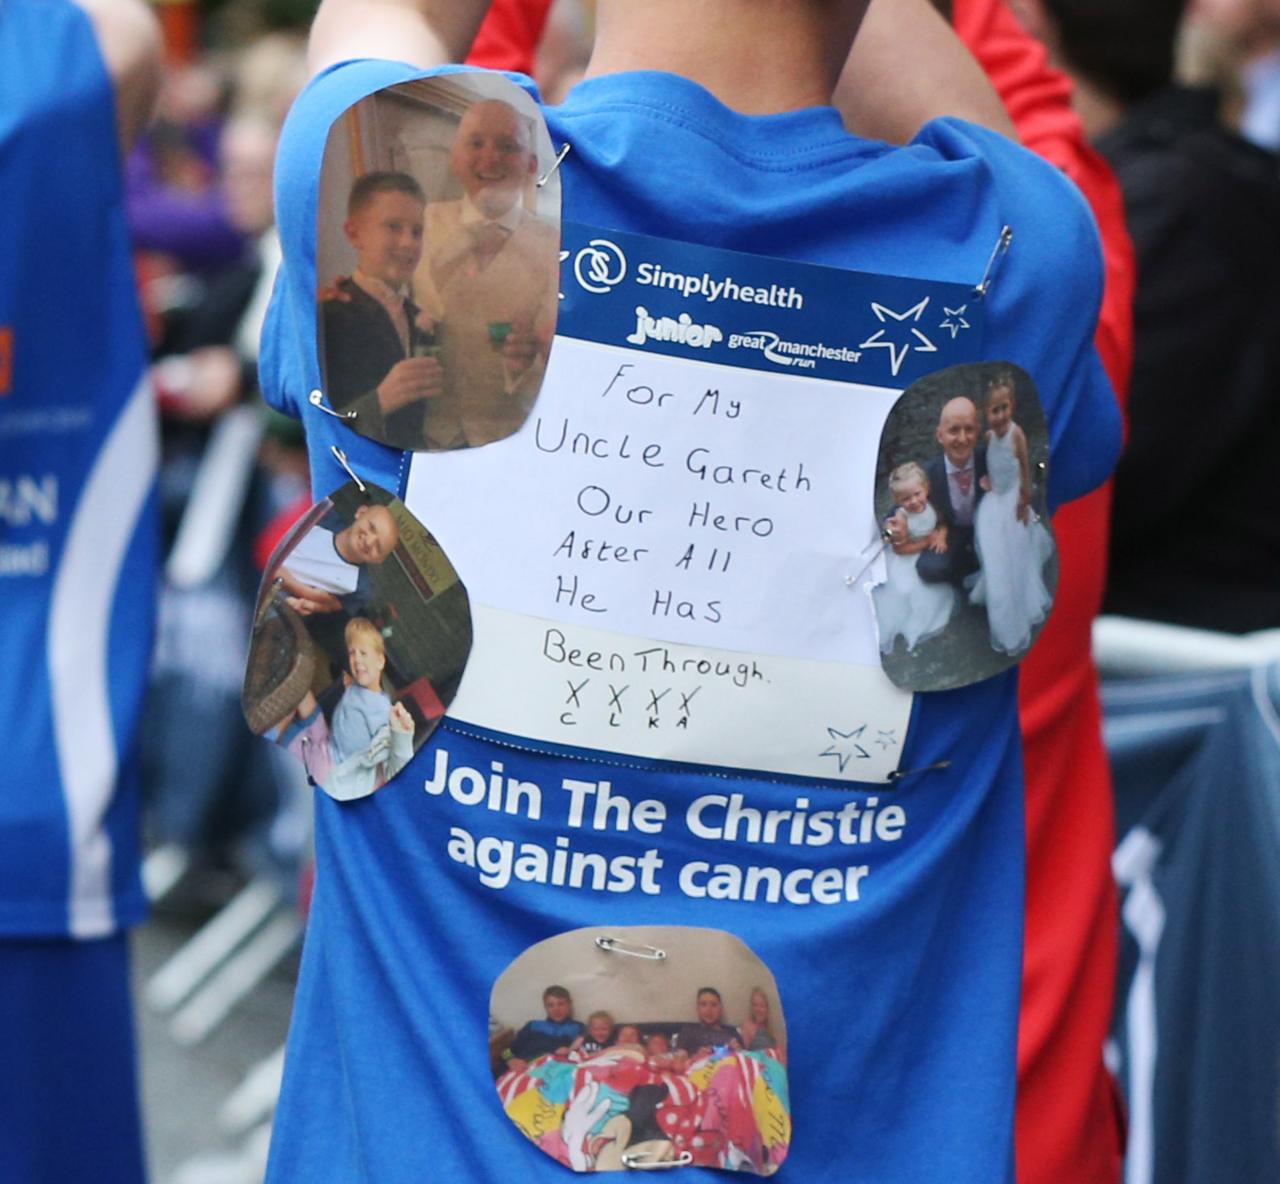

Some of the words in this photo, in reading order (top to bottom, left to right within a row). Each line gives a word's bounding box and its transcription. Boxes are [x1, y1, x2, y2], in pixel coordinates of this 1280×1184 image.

[635, 262, 804, 310] Simplyhealth
[626, 306, 723, 349] junior
[728, 332, 766, 350] great
[778, 340, 862, 363] manchester
[791, 357, 816, 370] run
[601, 364, 675, 407] For
[692, 388, 741, 419] My
[535, 417, 665, 467] Uncle
[686, 448, 811, 492] Gareth
[577, 485, 653, 524] Our
[688, 502, 774, 537] Hero
[675, 543, 731, 572] All
[555, 575, 608, 612] He
[651, 590, 722, 623] Has
[543, 628, 625, 672] Been
[424, 748, 542, 821] Join
[561, 778, 667, 834] The
[685, 793, 907, 846] Christie
[446, 826, 664, 894] against
[678, 860, 869, 905] cancer
